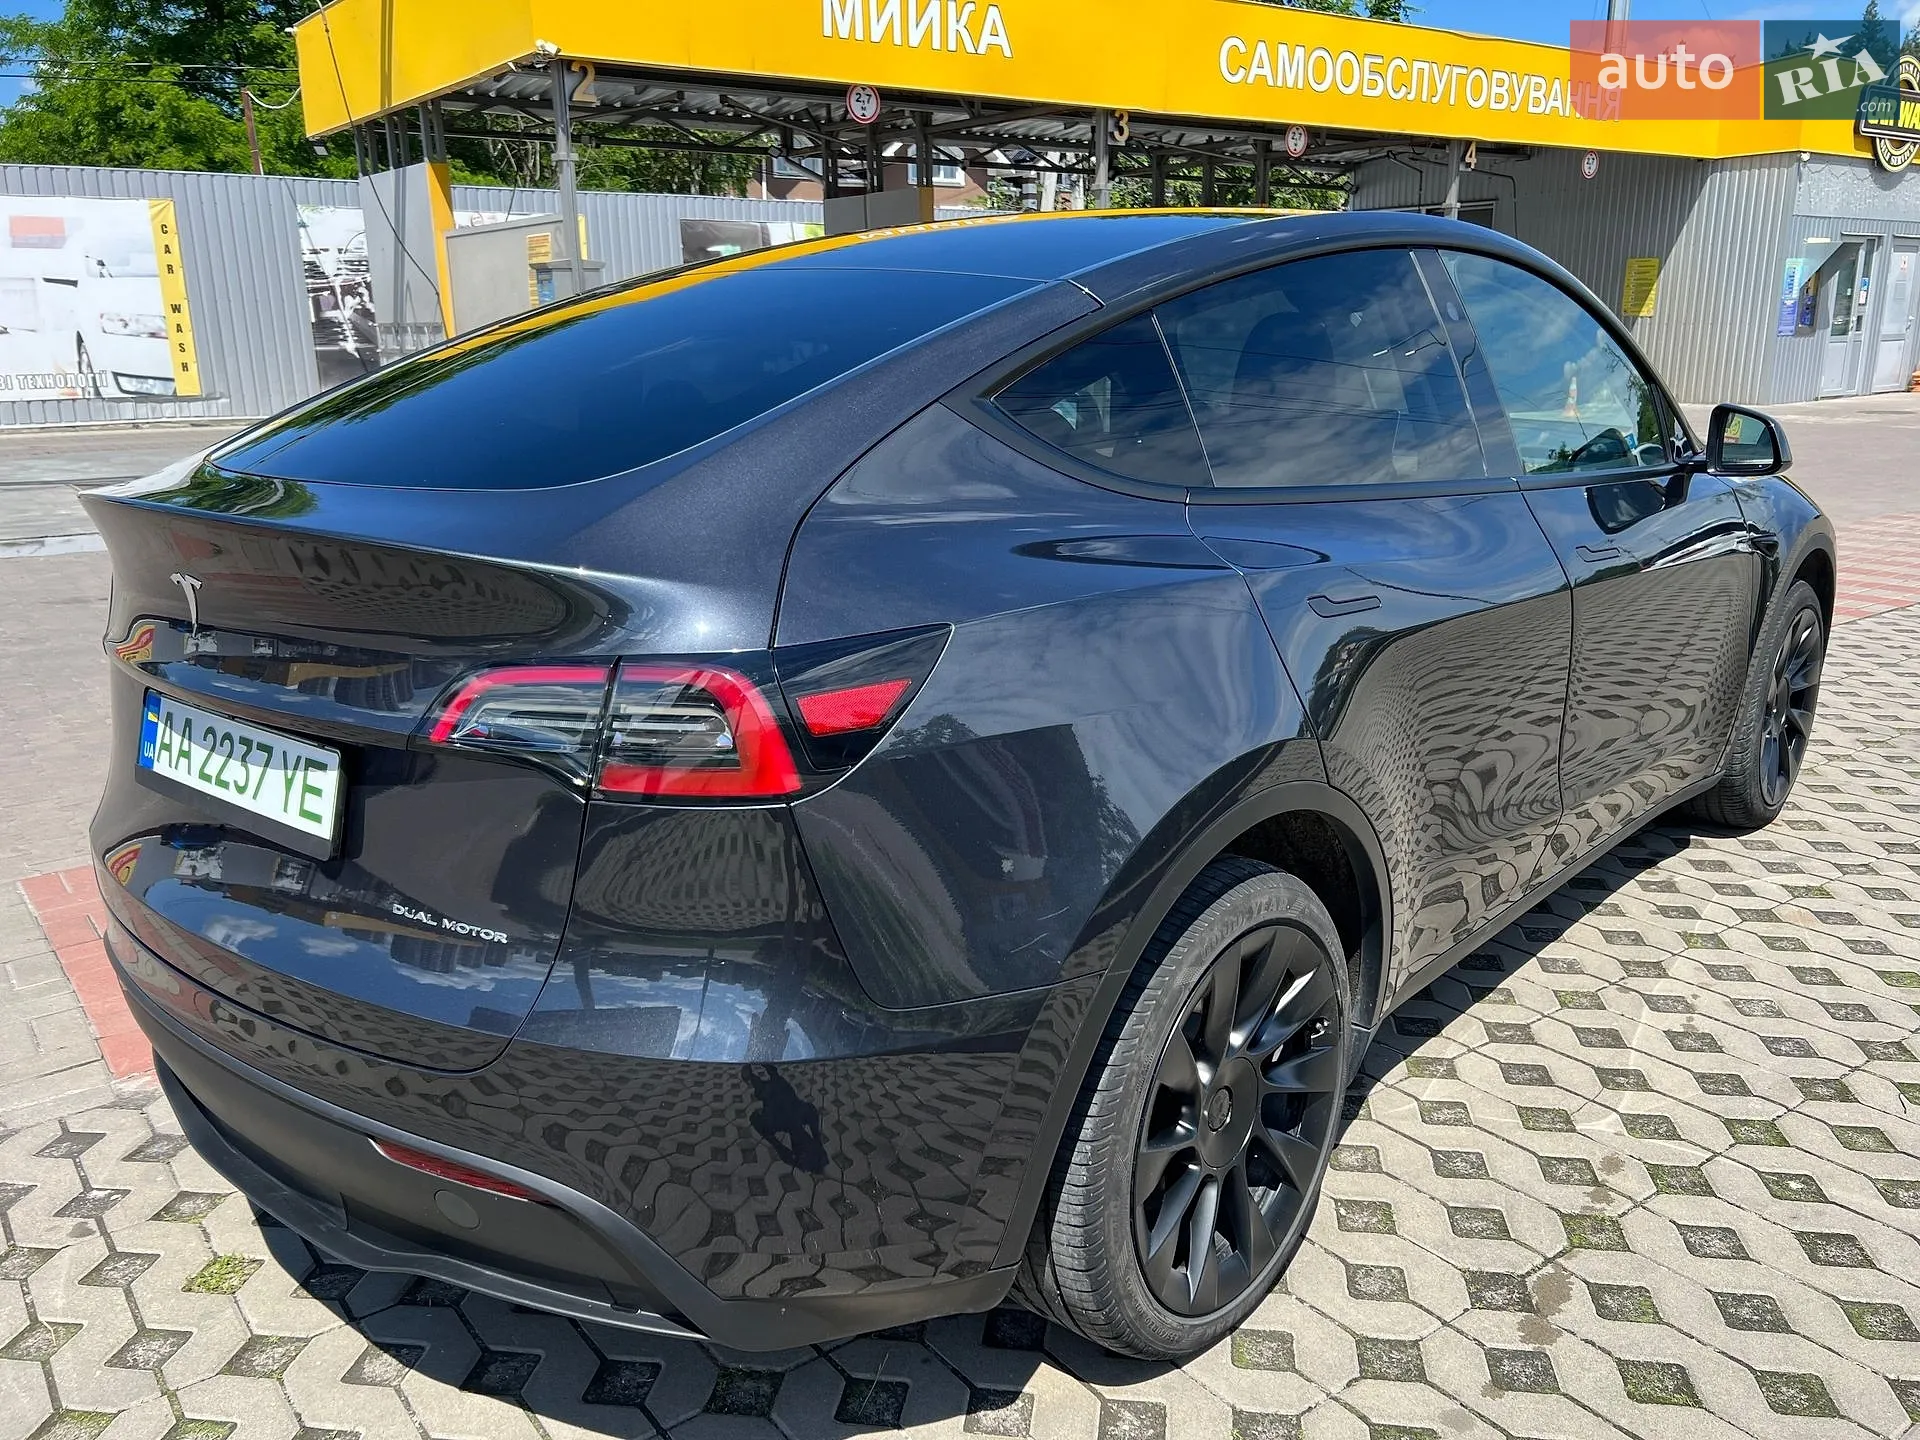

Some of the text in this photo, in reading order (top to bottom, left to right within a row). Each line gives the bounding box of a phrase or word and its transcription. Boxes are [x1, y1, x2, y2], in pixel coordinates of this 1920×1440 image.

[571, 60, 597, 102] 2
[1218, 35, 1620, 122] САМООБСЛУГОВУВАННЯ
[1113, 110, 1129, 143] 3
[1867, 96, 1898, 127] CAR
[1465, 140, 1477, 168] 4
[161, 224, 190, 372] CAR WASH
[15, 370, 108, 390] ТЕХНОЛОГІЇ
[143, 741, 154, 760] UA
[157, 711, 329, 824] AA 2237 YE
[393, 903, 508, 944] DUAL MOTOR
